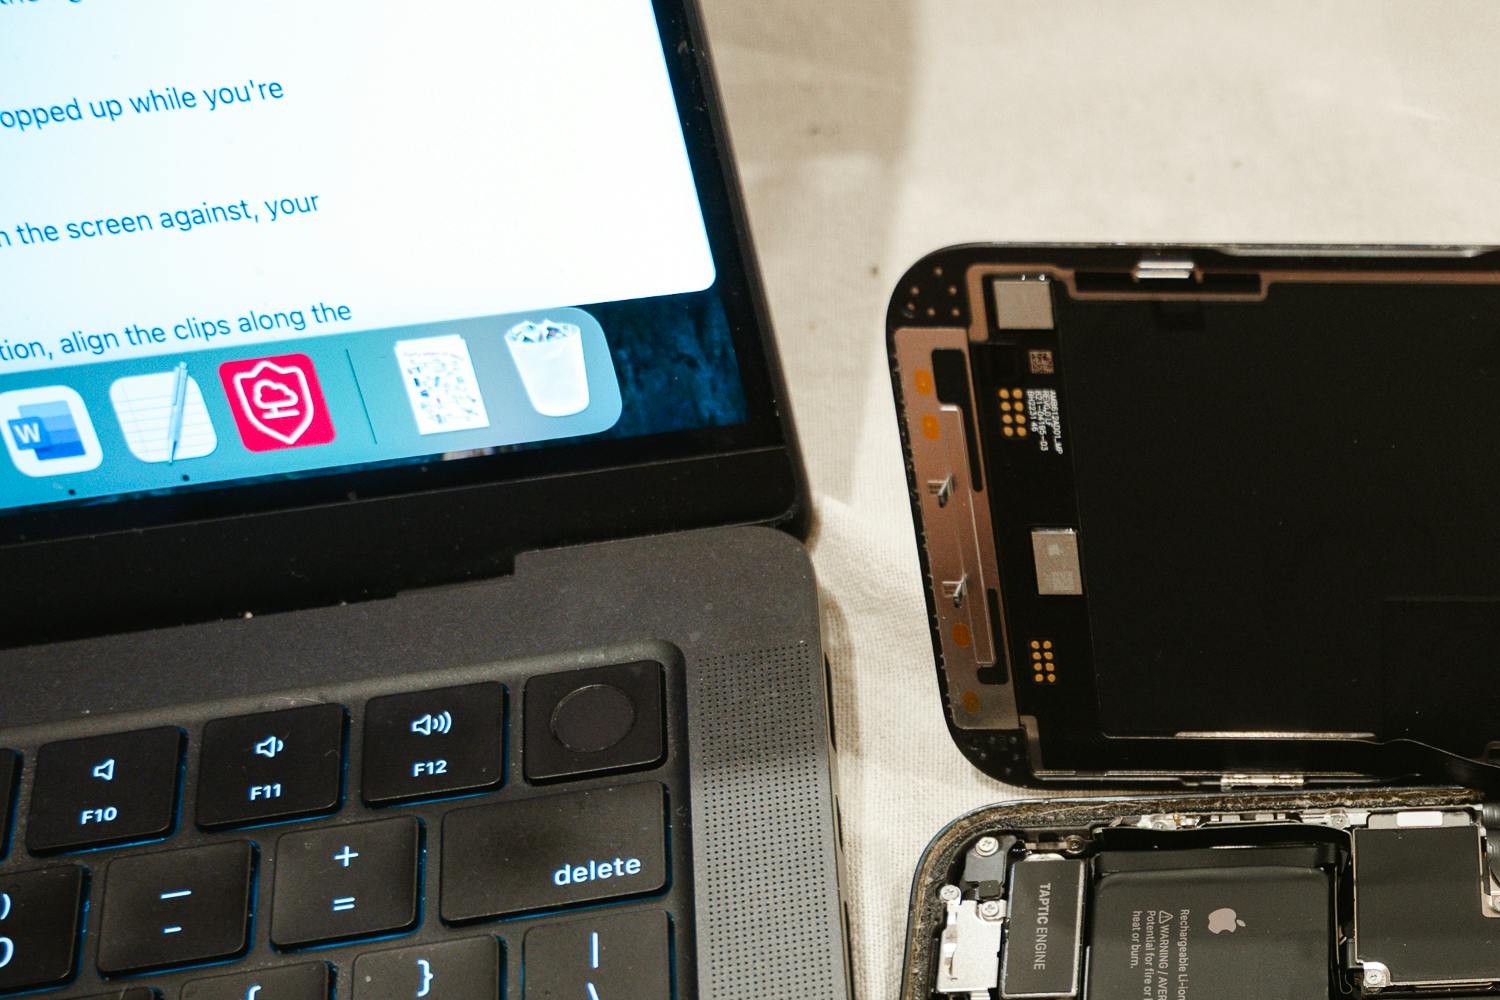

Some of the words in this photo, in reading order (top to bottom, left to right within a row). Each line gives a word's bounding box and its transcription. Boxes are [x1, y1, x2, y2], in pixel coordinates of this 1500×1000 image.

[89, 99, 123, 122] up
[129, 87, 197, 114] while
[203, 79, 284, 111] you're
[16, 222, 60, 244] the
[67, 211, 153, 240] screen
[160, 200, 259, 232] against,
[265, 195, 319, 221] your
[60, 330, 120, 355] align
[125, 323, 167, 346] the
[174, 317, 231, 342] clips
[238, 310, 307, 332] along
[312, 302, 352, 324] the
[14, 421, 41, 444] W
[414, 760, 448, 777] F12
[250, 783, 282, 801] F11
[80, 806, 118, 825] F10
[553, 857, 642, 886] delete
[1036, 882, 1052, 925] TAPTIC
[1132, 910, 1142, 931] heat
[1145, 910, 1156, 951] Potential
[1033, 927, 1048, 971] ENGINE
[1131, 932, 1140, 943] or
[1158, 924, 1170, 969] WARNING
[1178, 909, 1190, 972] Rechargeable
[1130, 944, 1141, 969] burn.
[1145, 953, 1155, 966] for
[1144, 968, 1155, 984] fire
[1143, 986, 1152, 996] or
